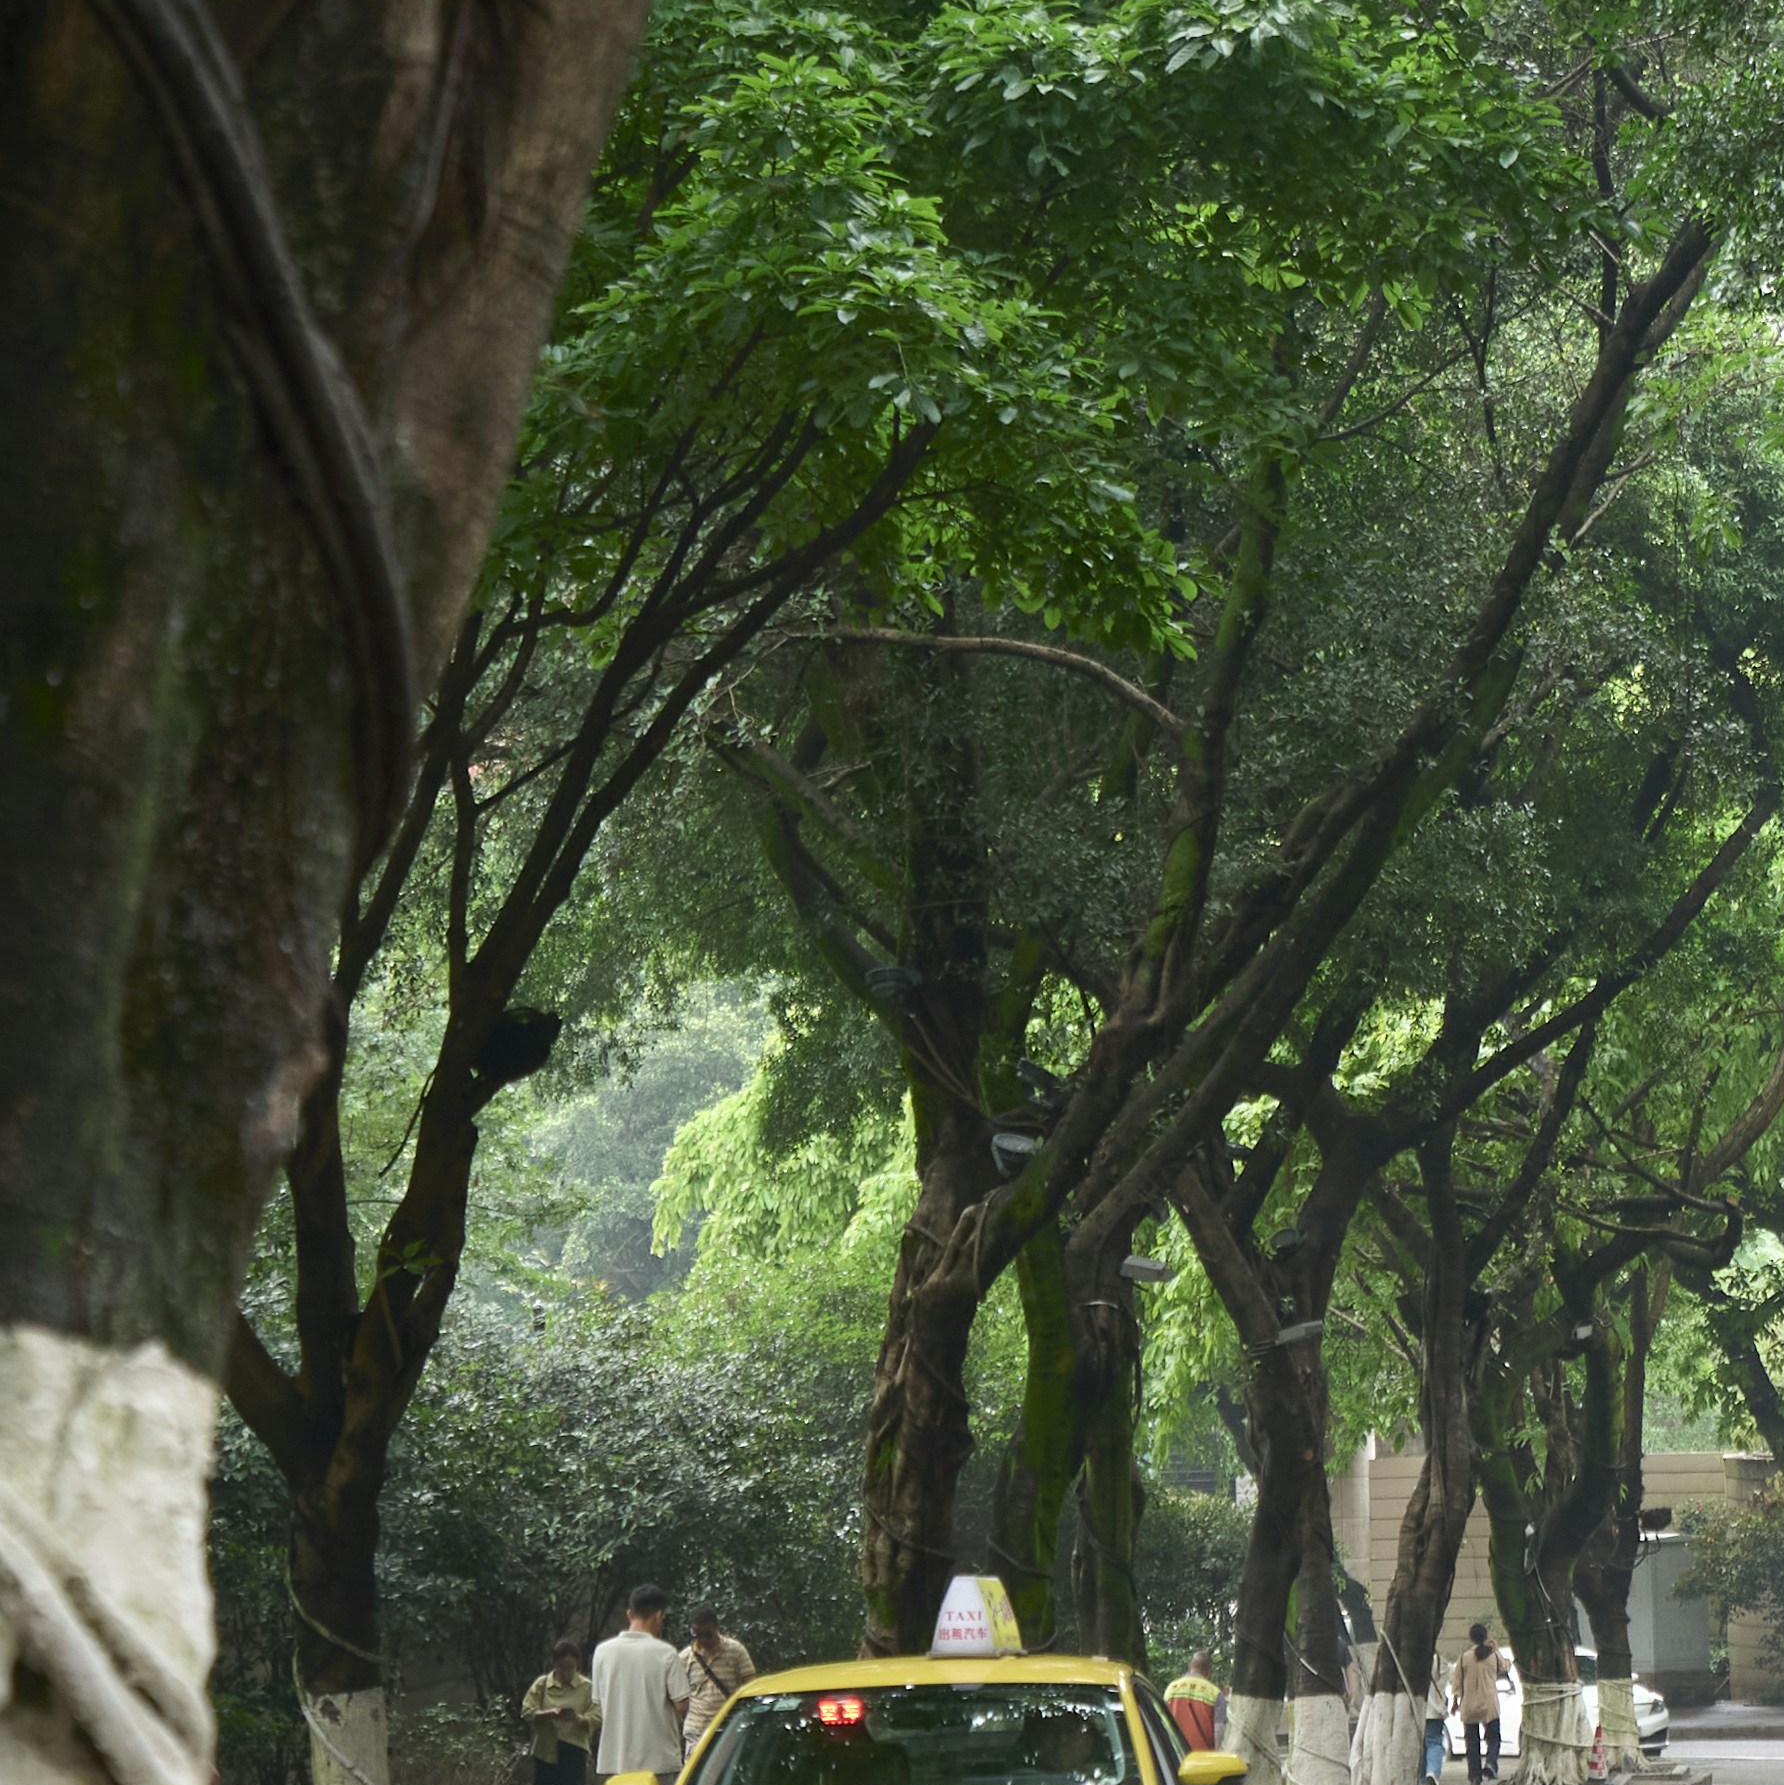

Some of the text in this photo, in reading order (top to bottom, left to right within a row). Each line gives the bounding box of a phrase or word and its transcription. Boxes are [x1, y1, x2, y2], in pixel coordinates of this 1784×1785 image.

[945, 1611, 983, 1621] TAXI
[938, 1627, 988, 1641] 出租汽车
